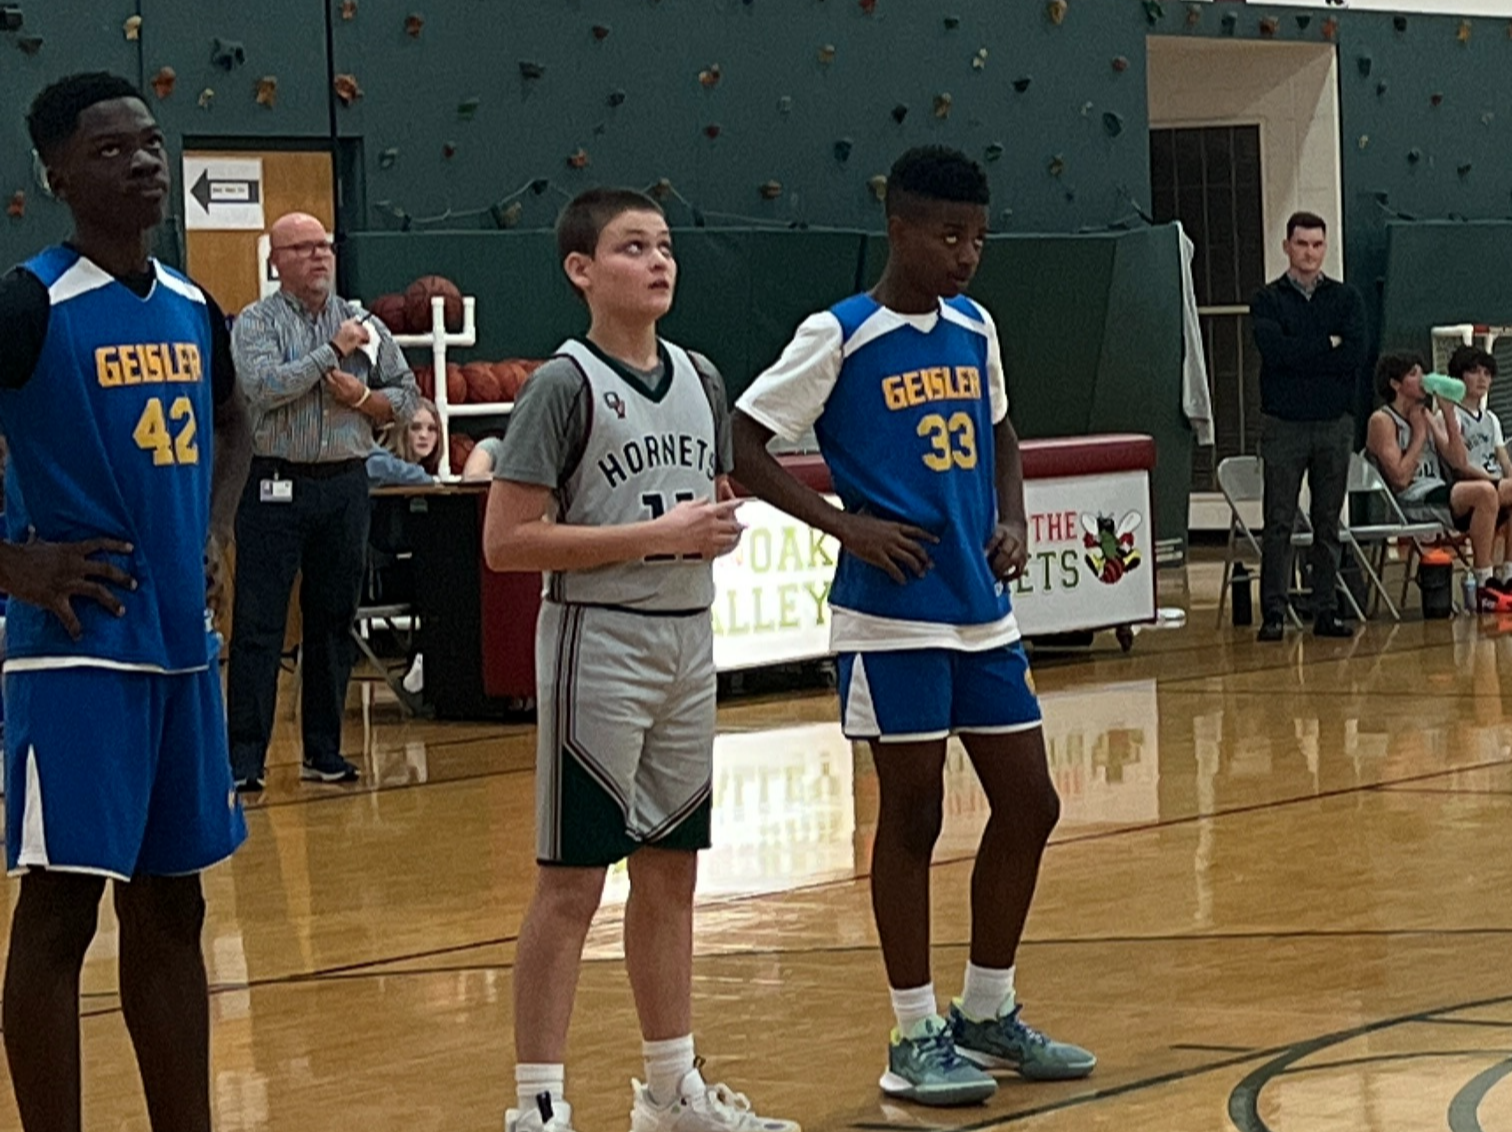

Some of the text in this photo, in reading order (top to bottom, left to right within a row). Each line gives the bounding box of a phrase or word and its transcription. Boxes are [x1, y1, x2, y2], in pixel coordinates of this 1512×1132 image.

[95, 343, 202, 388] GEISLER
[882, 366, 981, 410] GEISLER
[133, 397, 198, 466] 42
[916, 412, 977, 471] 33
[1031, 511, 1078, 543] THE
[750, 527, 833, 573] OAK
